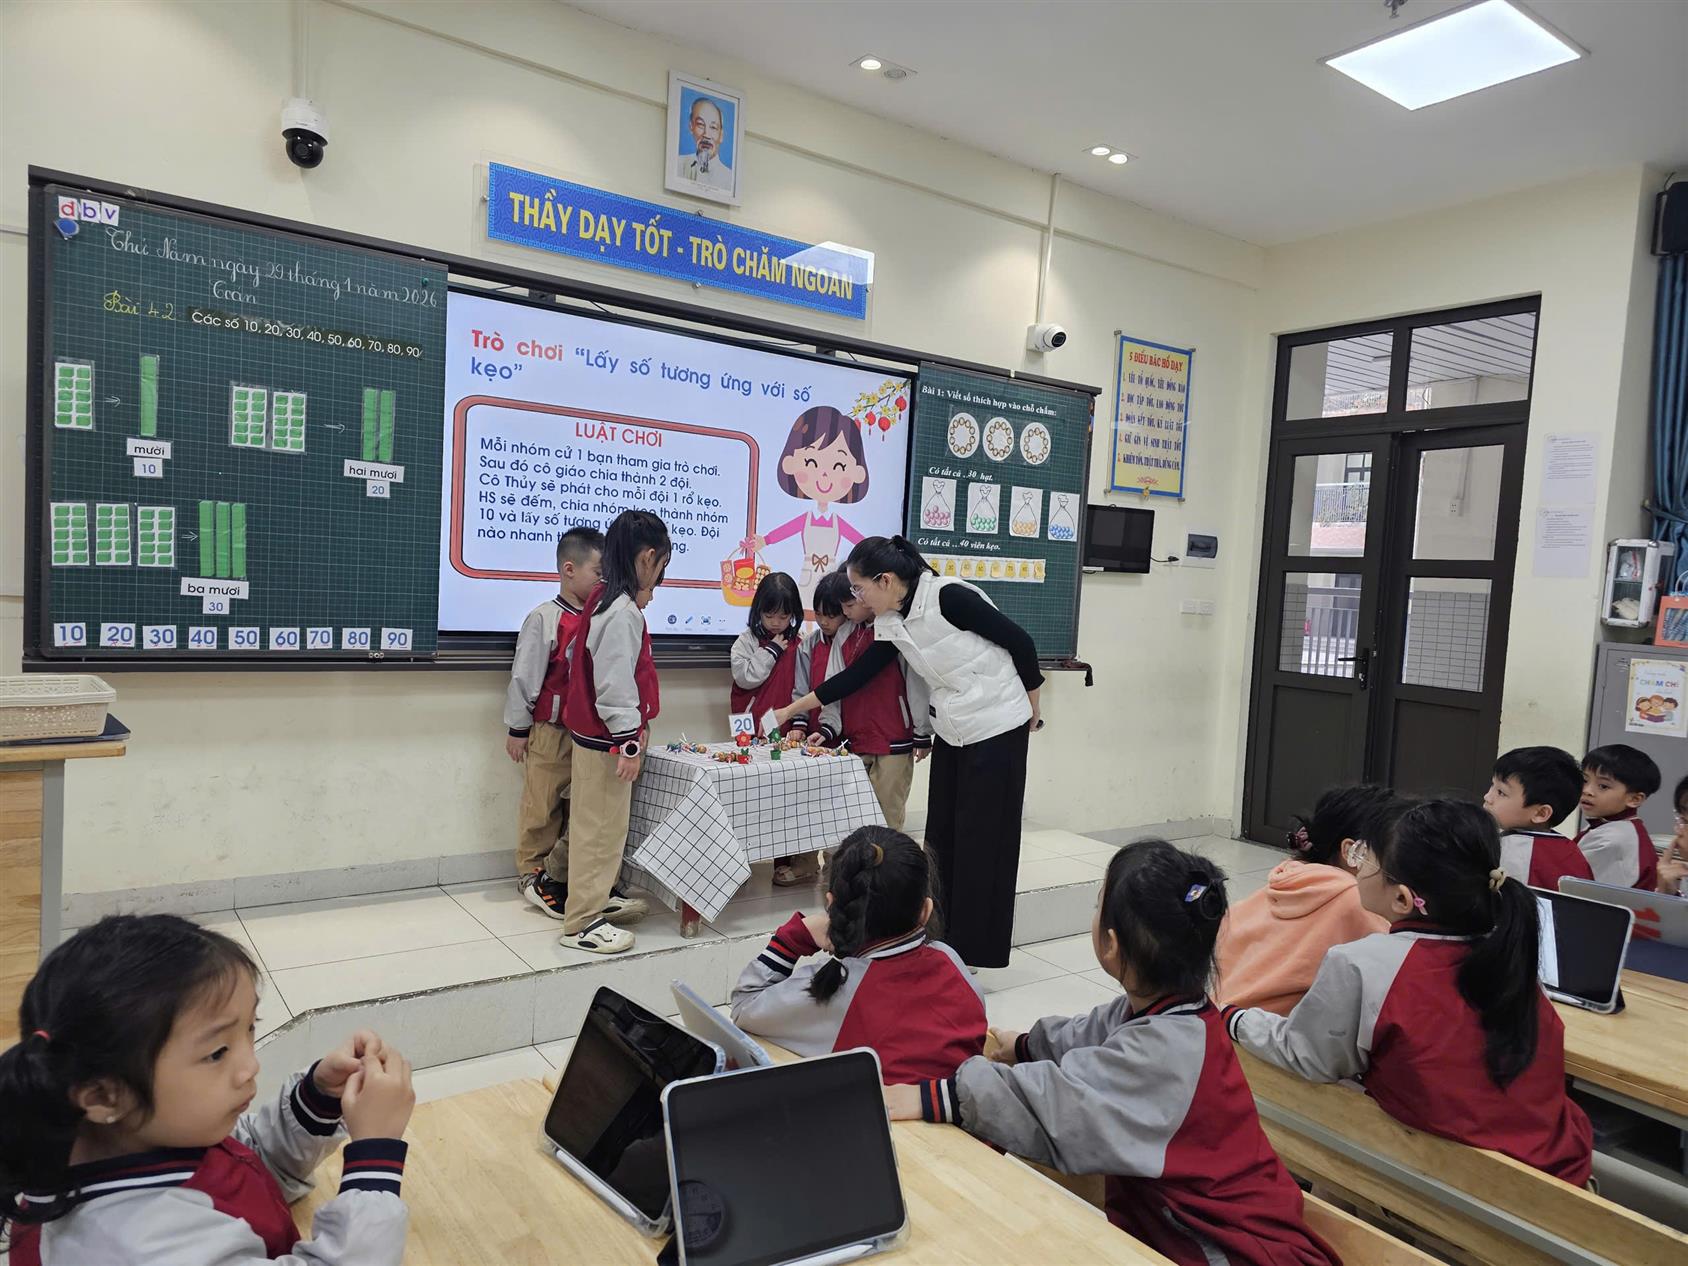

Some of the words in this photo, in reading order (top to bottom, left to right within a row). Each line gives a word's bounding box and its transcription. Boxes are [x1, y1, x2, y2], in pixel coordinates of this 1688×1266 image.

[61, 201, 75, 217] d
[83, 202, 97, 219] b
[105, 208, 116, 220] v
[508, 188, 573, 235] THẦY
[579, 208, 627, 252] DẠY
[632, 214, 673, 257] TỐT
[688, 235, 727, 271] TRÒ
[732, 245, 787, 285] CHĂM
[791, 261, 853, 300] NGOAN
[211, 256, 260, 287] ngày
[265, 260, 284, 280] 29
[287, 260, 341, 300] tháng
[344, 277, 351, 292] 1
[355, 281, 400, 302] năm
[402, 286, 438, 308] 2026
[103, 290, 140, 315] Bài
[191, 311, 221, 327] Các
[225, 314, 240, 329] số
[244, 319, 262, 334] 10,
[264, 323, 283, 337] 20,
[285, 327, 304, 340] 30,
[306, 331, 325, 344] 40,
[327, 334, 345, 347] 50,
[347, 337, 365, 350] 60,
[368, 340, 385, 353] 70,
[387, 343, 404, 356] 80,
[471, 328, 505, 352] Trò
[516, 340, 563, 361] chơi
[575, 347, 619, 374] “Lấy
[629, 357, 652, 375] số
[660, 362, 711, 390] tương
[720, 372, 752, 396] ứng
[761, 381, 785, 398] với
[793, 385, 812, 402] số
[471, 356, 523, 382] kẹo”
[921, 385, 935, 395] Bài
[936, 388, 945, 397] 1:
[946, 389, 962, 400] Viết
[963, 391, 971, 402] số
[972, 395, 992, 406] thích
[992, 399, 1007, 409] hợp
[1008, 401, 1021, 410] vào
[1022, 403, 1034, 413] chỗ
[1036, 405, 1057, 416] chấm:
[575, 421, 617, 443] LUẬT
[621, 428, 663, 448] CHƠI
[134, 445, 165, 456] mười
[480, 436, 507, 452] Mỗi
[511, 441, 551, 457] nhóm
[554, 445, 573, 460] cử
[577, 448, 582, 461] 1
[587, 449, 613, 466] bạn
[616, 453, 648, 468] tham
[651, 458, 671, 472] gia
[674, 460, 690, 473] trò
[692, 464, 721, 477] chơi.
[142, 463, 156, 474] 10
[349, 465, 367, 476] hai
[369, 469, 397, 480] mươi
[479, 455, 506, 470] Sau
[510, 459, 529, 472] đó
[533, 462, 551, 474] cô
[555, 464, 586, 479] giáo
[589, 468, 618, 481] chia
[621, 471, 656, 486] thành
[659, 474, 667, 486] 2
[669, 477, 692, 491] đội.
[928, 466, 939, 475] Có
[941, 466, 951, 476] tất
[371, 485, 385, 495] 20
[479, 472, 500, 487] Cô
[504, 474, 537, 492] Thủy
[540, 479, 556, 492] sẽ
[560, 481, 591, 495] phát
[594, 485, 619, 498] cho
[622, 485, 646, 500] mỗi
[649, 490, 669, 504] đội
[673, 492, 678, 503] 1
[682, 491, 695, 505] rổ
[697, 494, 722, 509] kẹo.
[479, 490, 496, 504] HS
[500, 493, 516, 506] sẽ
[520, 493, 557, 511] đếm,
[560, 498, 589, 512] chia
[593, 501, 629, 514] nhóm
[660, 507, 693, 521] thành
[696, 511, 729, 523] nhóm
[477, 525, 506, 540] nào
[510, 528, 553, 542] nhanh
[480, 507, 495, 521] 10
[499, 509, 517, 522] và
[521, 511, 540, 526] lấy
[544, 512, 561, 526] số
[563, 514, 600, 530] tương
[671, 524, 697, 537] kẹo.
[701, 526, 720, 539] Đội
[917, 537, 929, 546] Có
[930, 536, 941, 546] tất
[970, 541, 985, 550] viên
[986, 541, 1001, 552] kẹo.
[187, 583, 205, 594] ba
[208, 586, 240, 596] mươi
[208, 601, 224, 612] 30
[59, 625, 84, 642] 10
[107, 626, 133, 643] 20
[149, 628, 175, 644] 30
[190, 629, 216, 645] 40
[234, 630, 258, 646] 50
[275, 631, 298, 646] 60
[309, 630, 331, 645] 70
[347, 631, 369, 646] 80
[387, 632, 408, 646] 90
[733, 717, 753, 733] 20
